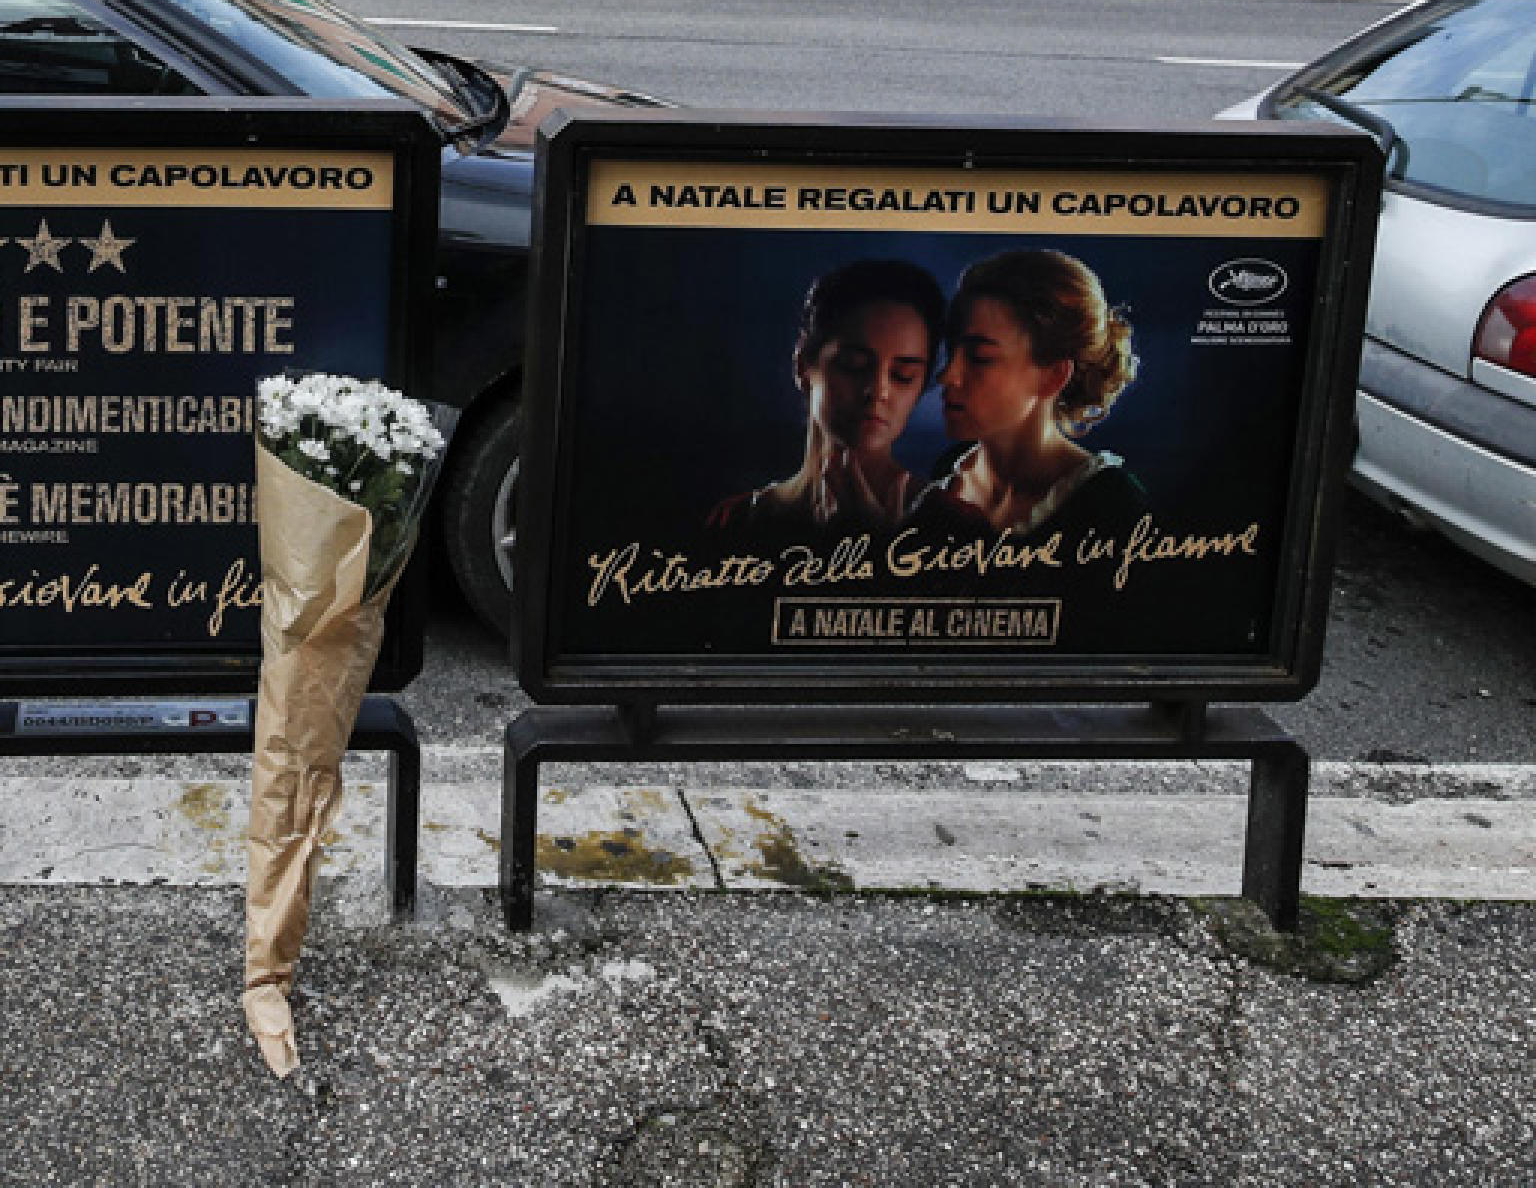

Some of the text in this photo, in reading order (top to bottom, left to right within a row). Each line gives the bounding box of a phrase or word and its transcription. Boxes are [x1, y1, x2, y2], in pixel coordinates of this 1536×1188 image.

[42, 164, 97, 187] UN
[110, 163, 374, 190] CAPOLAVORO
[612, 183, 1301, 220] A NATALE REGALATI UN CAPOLAVORO
[21, 296, 49, 352] E
[66, 296, 295, 354] POTENTE
[1197, 320, 1289, 334] PALMA D'ORO
[35, 359, 79, 373] FAIR
[587, 542, 775, 606] Ritratto
[1075, 527, 1115, 565] in
[167, 568, 208, 605] in
[789, 608, 1049, 639] A NATALE AL CINEMA
